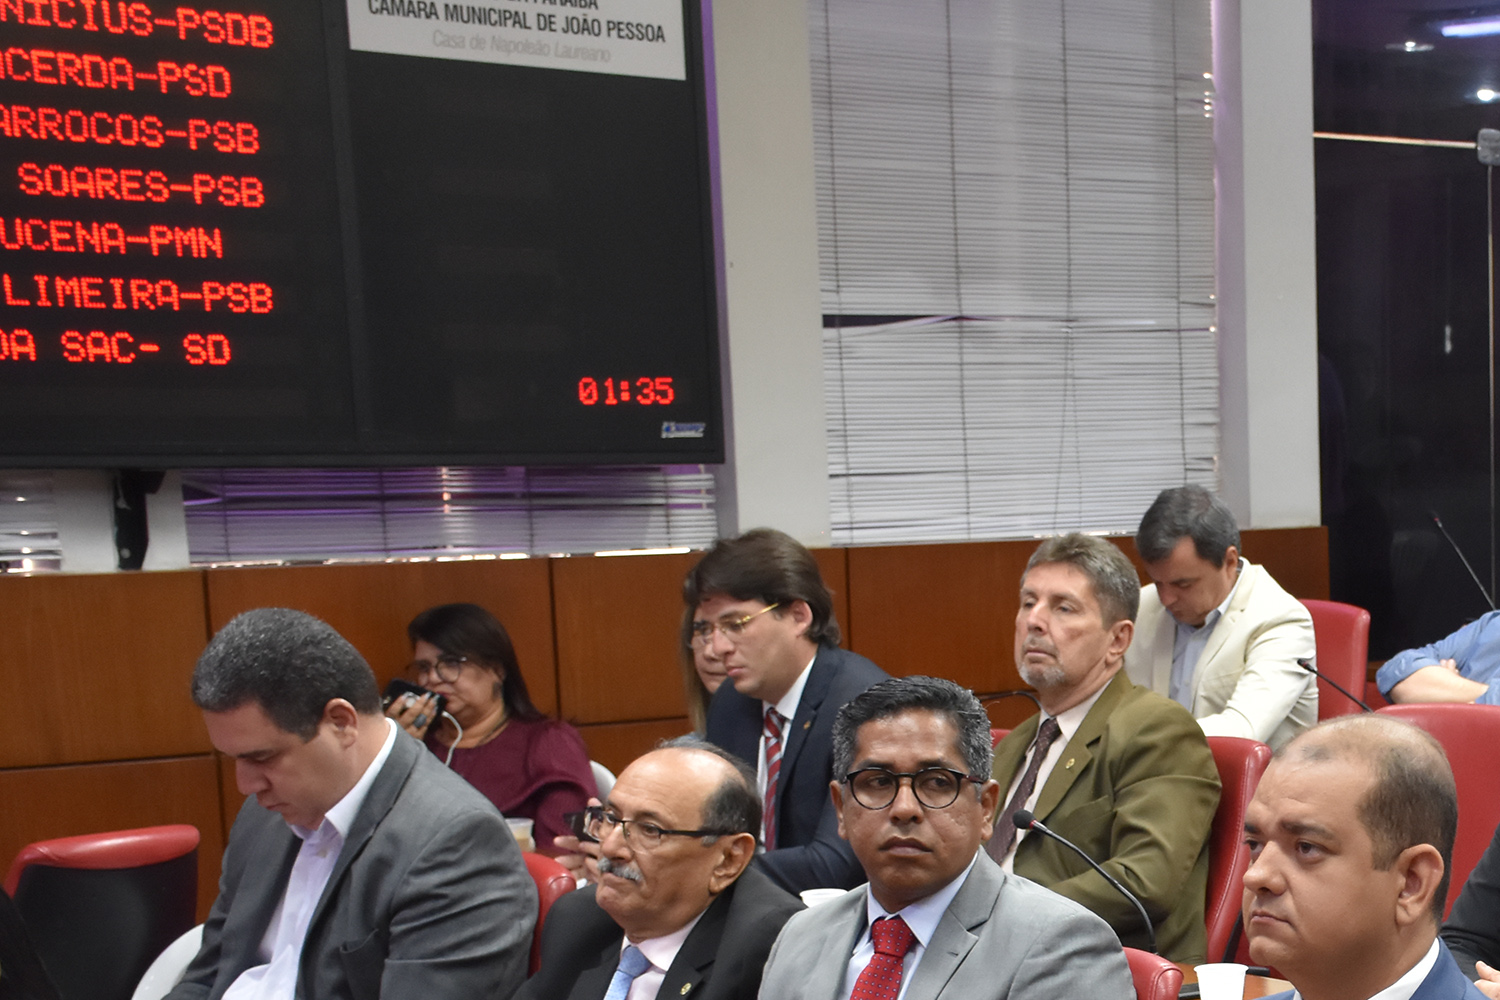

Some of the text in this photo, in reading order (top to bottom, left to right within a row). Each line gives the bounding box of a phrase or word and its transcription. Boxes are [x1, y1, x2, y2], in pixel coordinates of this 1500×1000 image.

[432, 29, 466, 49] Casa
[469, 33, 486, 51] de
[444, 4, 532, 30] MUNICIPAL
[536, 13, 557, 32] DE
[562, 13, 602, 37] JOÃO
[606, 20, 666, 43] PESSOA
[0, 47, 232, 98] CERDA-PSD
[17, 162, 265, 208] SOARES-PSB
[2, 273, 274, 314] LIMEIRA-PSB
[182, 333, 232, 366] SD
[578, 377, 674, 405] 01:35
